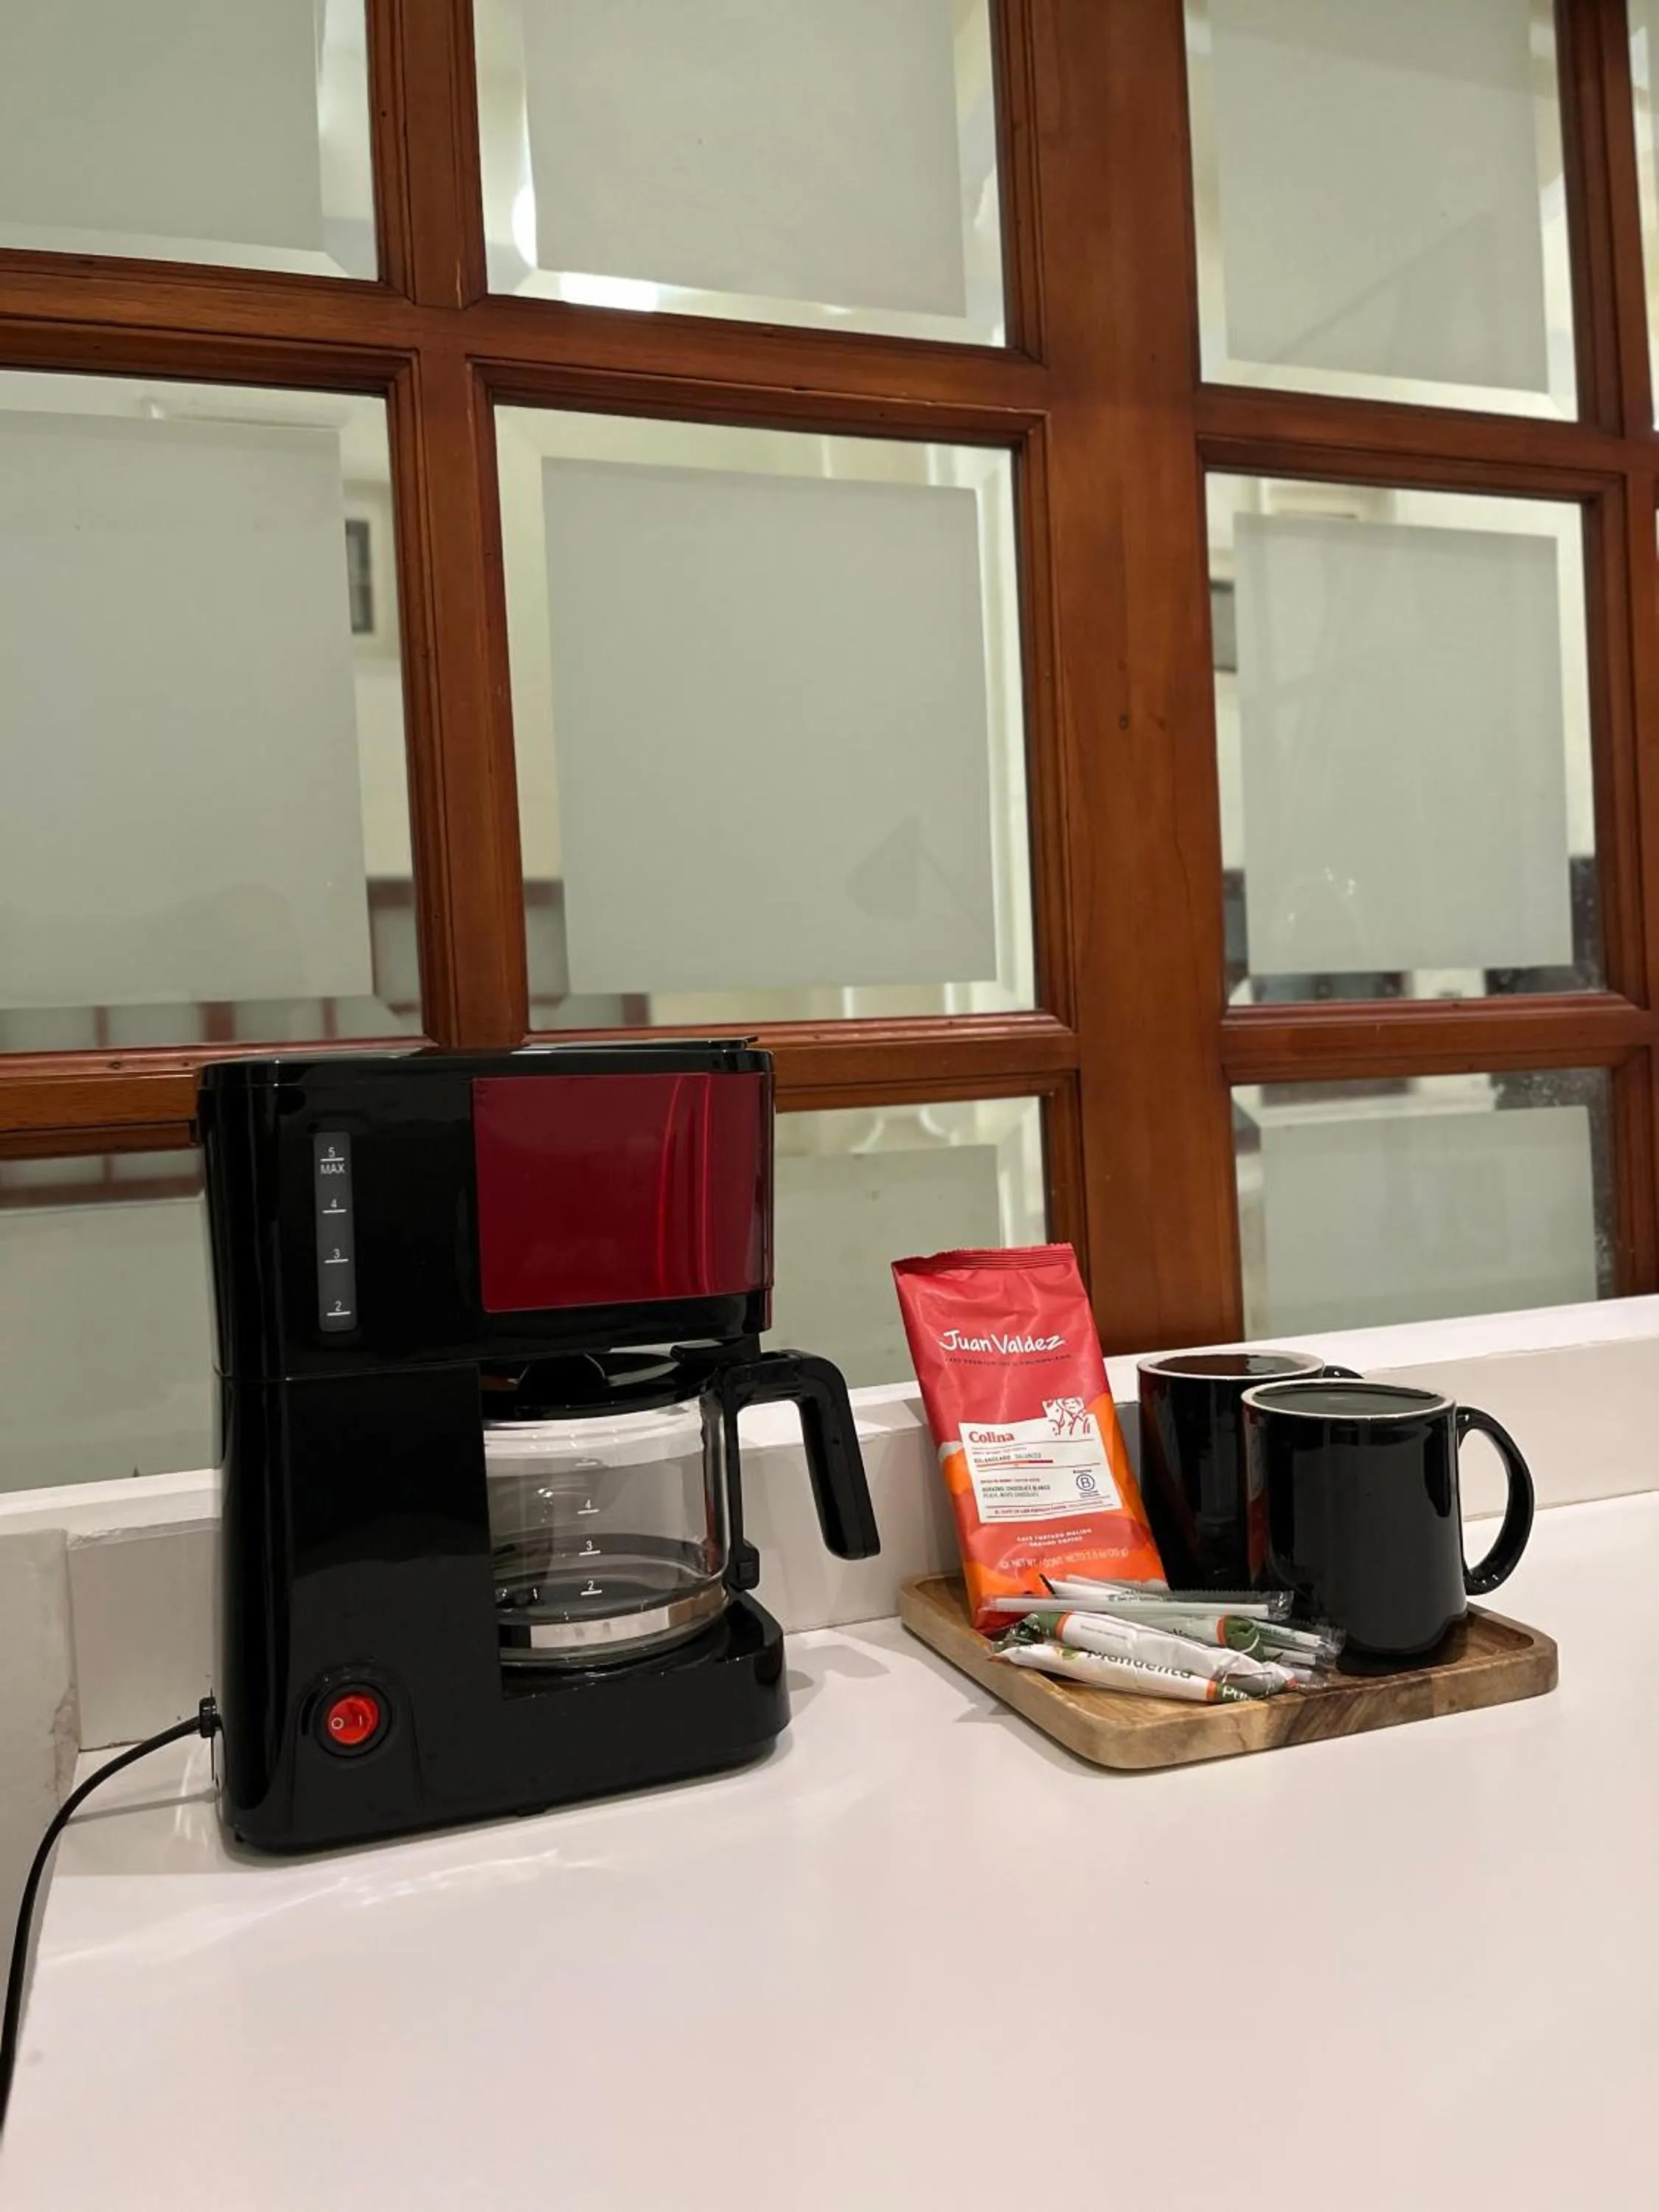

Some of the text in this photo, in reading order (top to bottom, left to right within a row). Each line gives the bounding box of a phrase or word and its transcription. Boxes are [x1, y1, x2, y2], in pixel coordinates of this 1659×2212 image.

[328, 1147, 335, 1158] 5
[320, 1163, 345, 1175] MAX
[330, 1199, 338, 1208] 4
[333, 1248, 341, 1259] 3
[334, 1300, 342, 1312] 2
[939, 1329, 1066, 1354] Juan Valdez
[968, 1431, 1015, 1443] Colina
[585, 1498, 591, 1509] 4
[585, 1540, 593, 1551] 3
[587, 1580, 595, 1590] 2
